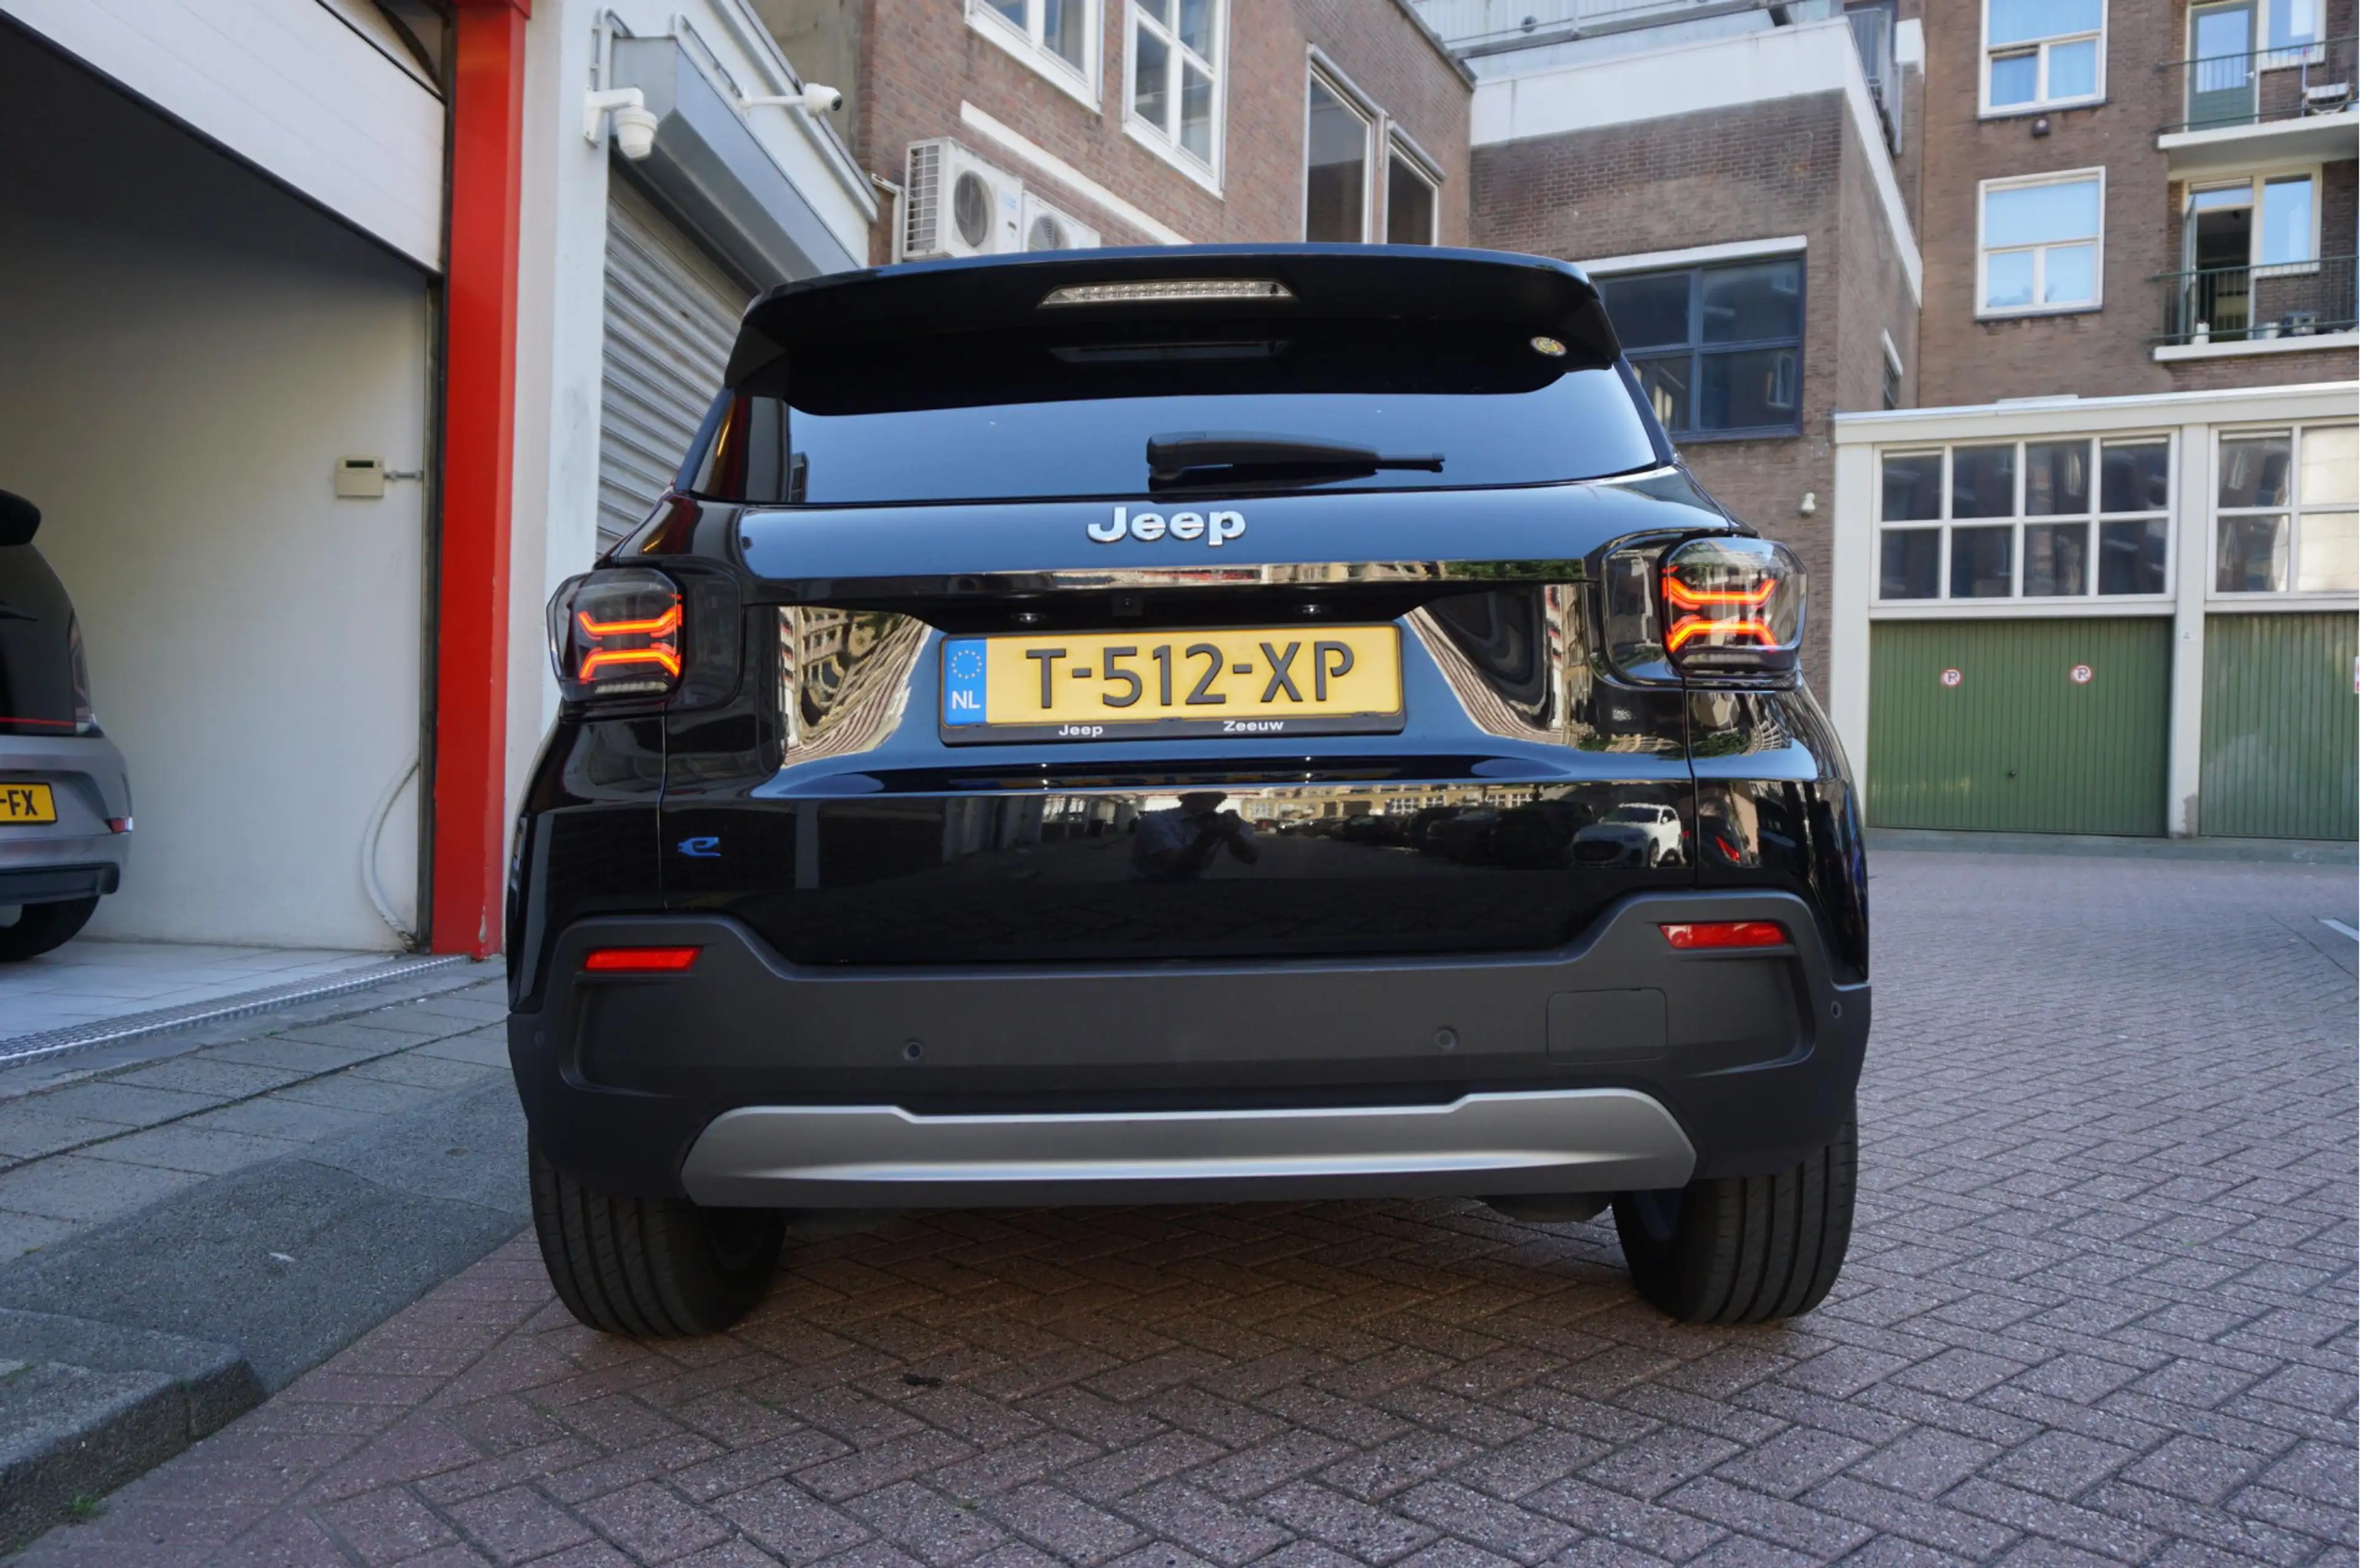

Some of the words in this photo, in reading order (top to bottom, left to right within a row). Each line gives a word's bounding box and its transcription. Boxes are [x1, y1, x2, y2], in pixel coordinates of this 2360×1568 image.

[1087, 507, 1246, 546] Jeep
[1025, 640, 1355, 709] T-512-XP
[951, 690, 981, 710] NL
[1058, 724, 1104, 737] Jeep
[1223, 720, 1284, 732] Zeeuw
